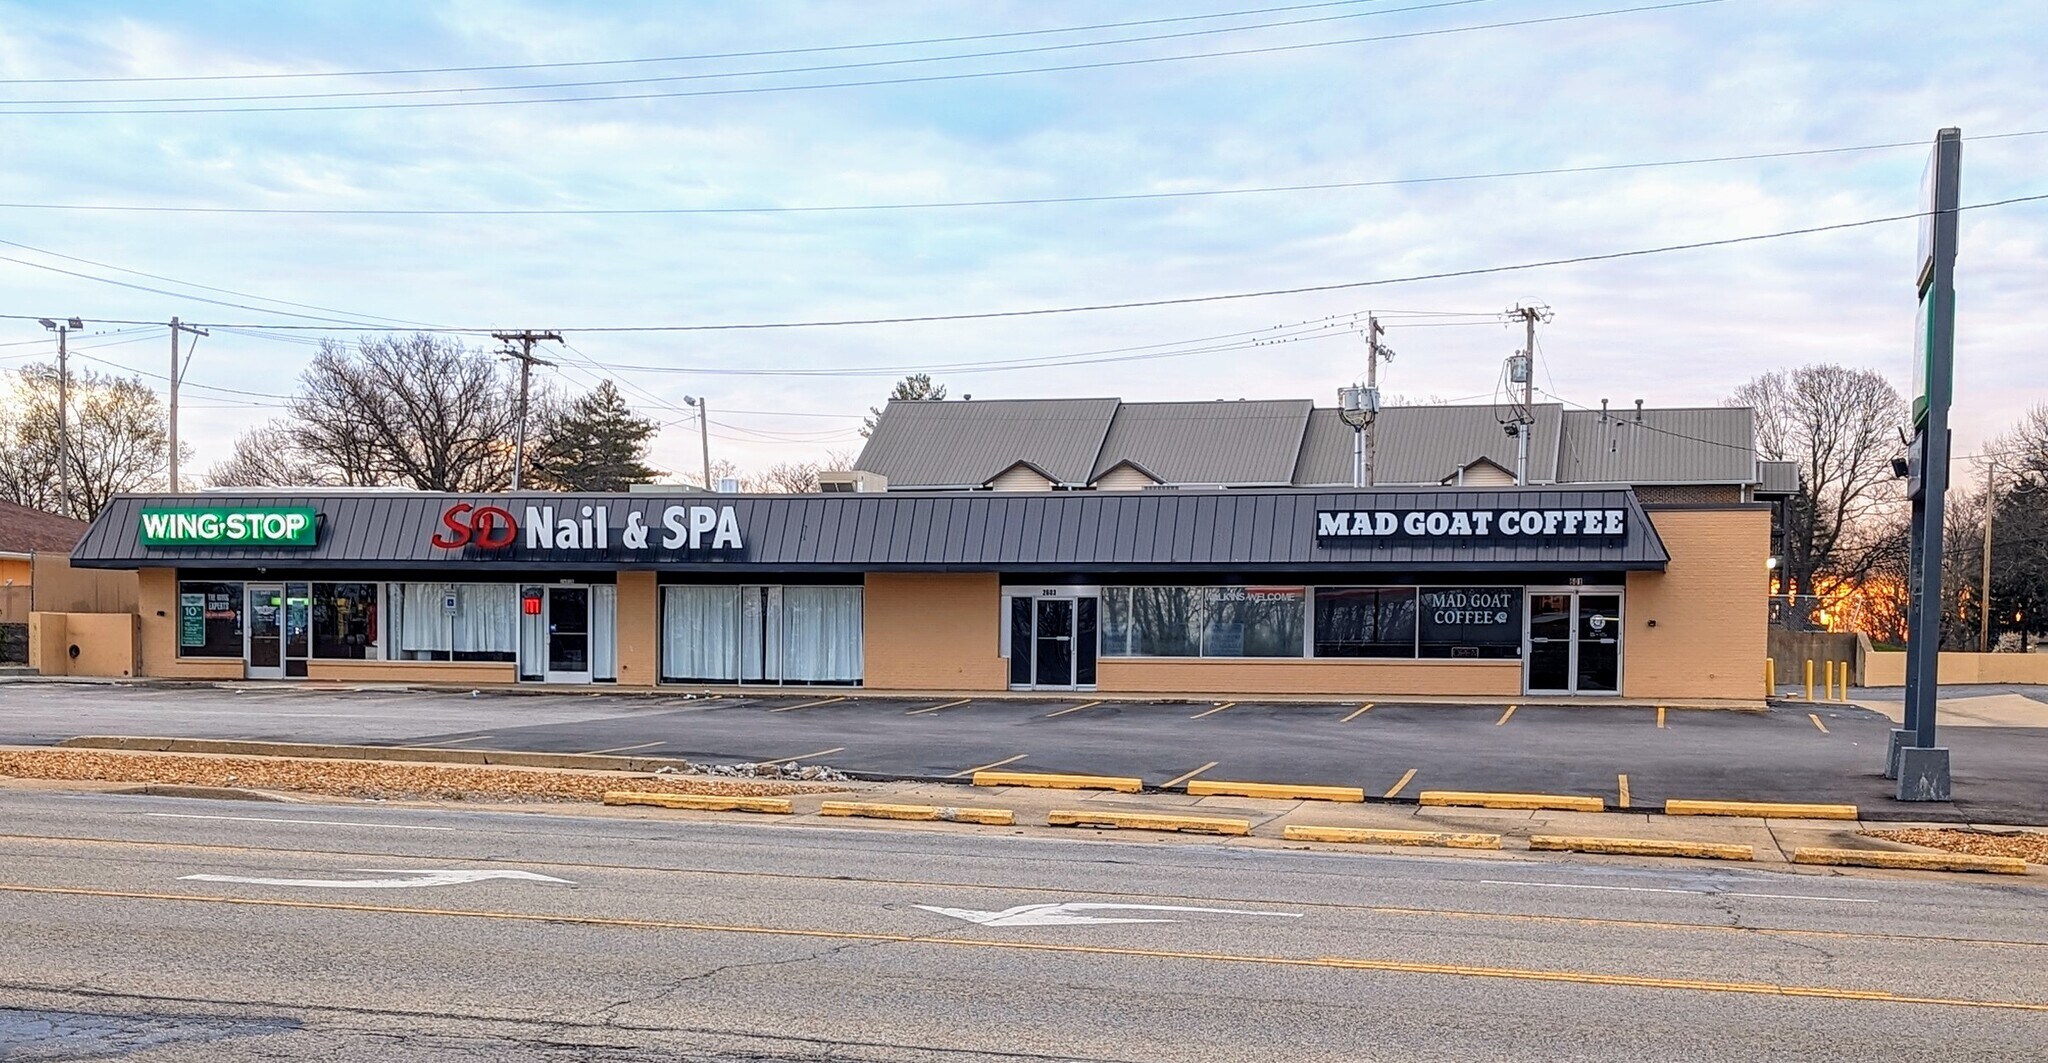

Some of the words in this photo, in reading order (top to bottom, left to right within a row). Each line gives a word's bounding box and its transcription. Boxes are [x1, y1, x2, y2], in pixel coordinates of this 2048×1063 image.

[432, 503, 518, 548] SD
[526, 506, 607, 549] Nail
[622, 511, 649, 549] &
[663, 505, 743, 549] SPA
[1318, 512, 1398, 536] MAD
[1403, 511, 1492, 536] GOAT
[1499, 510, 1624, 535] COFFEE
[1247, 592, 1296, 601] WELCOME
[1432, 594, 1467, 607] MAD
[1471, 593, 1511, 608] GOAT
[1434, 611, 1493, 624] COFFEE
